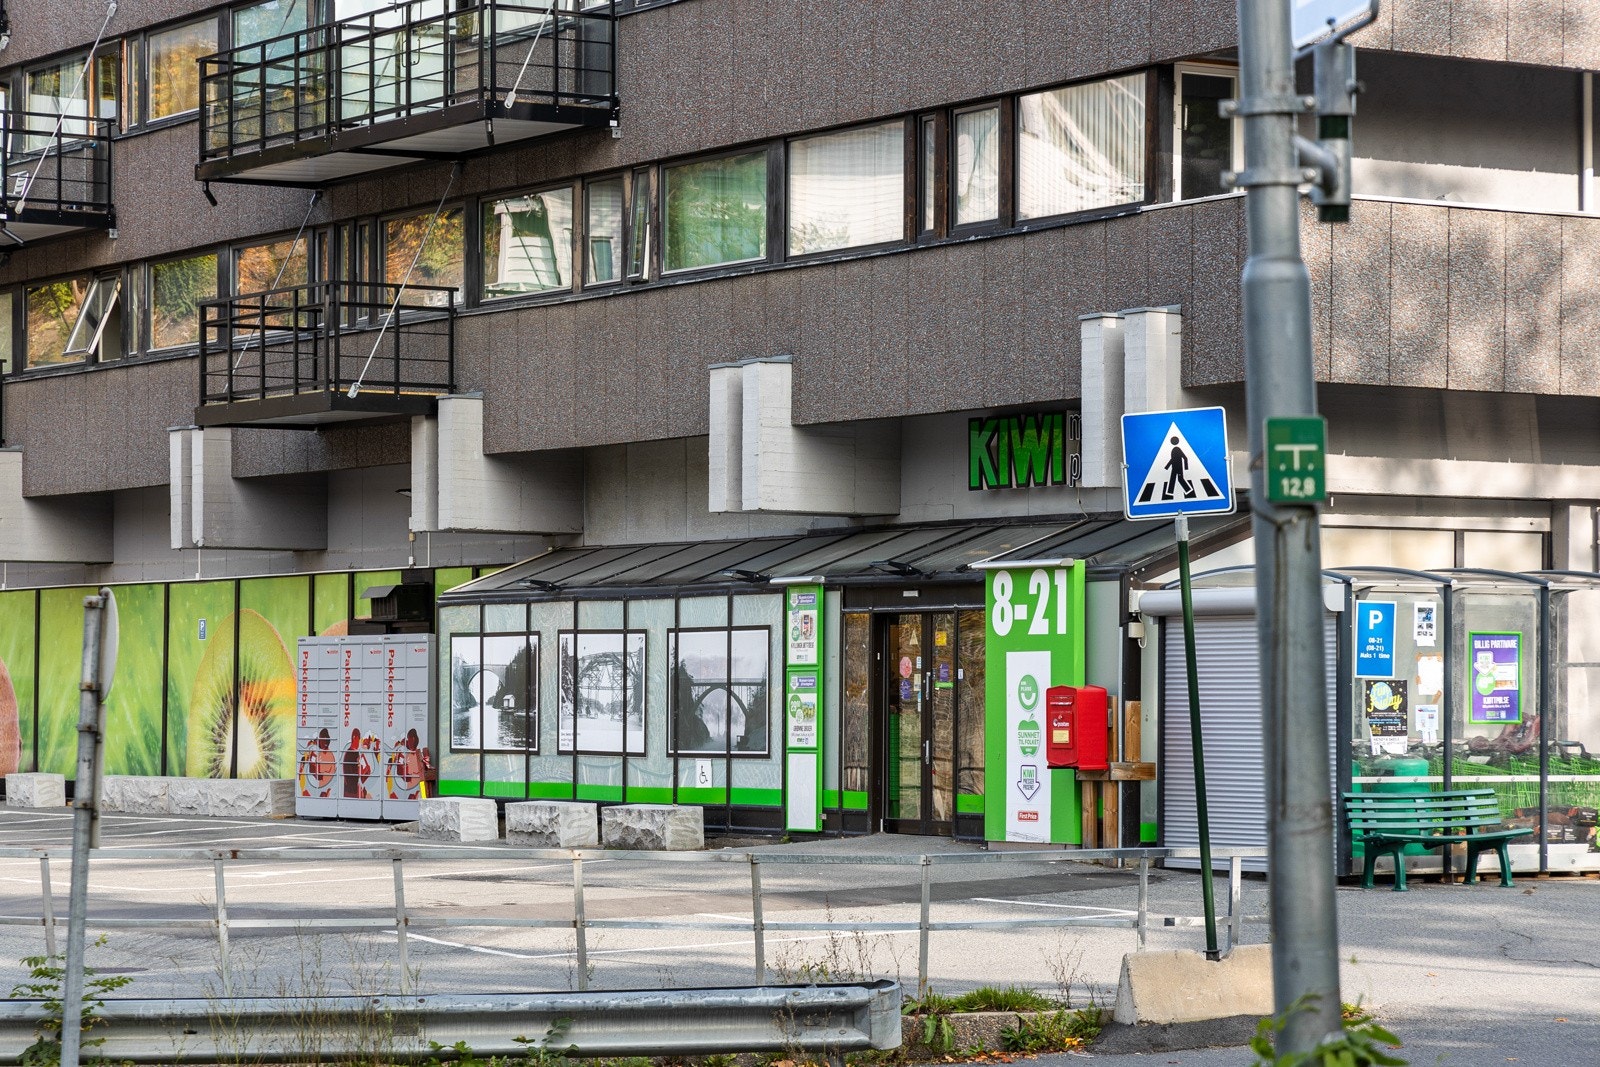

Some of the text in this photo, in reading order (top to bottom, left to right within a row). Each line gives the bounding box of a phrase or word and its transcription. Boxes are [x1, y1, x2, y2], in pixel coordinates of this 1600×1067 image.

[968, 413, 1066, 490] KIWI
[992, 569, 1067, 636] 8-21
[1369, 609, 1383, 630] P
[301, 651, 309, 727] Pakkeboks
[343, 650, 351, 727] Pakkeboks
[387, 649, 395, 728] Pakkeboks
[1023, 770, 1035, 778] KIWI
[1028, 812, 1038, 820] Price
